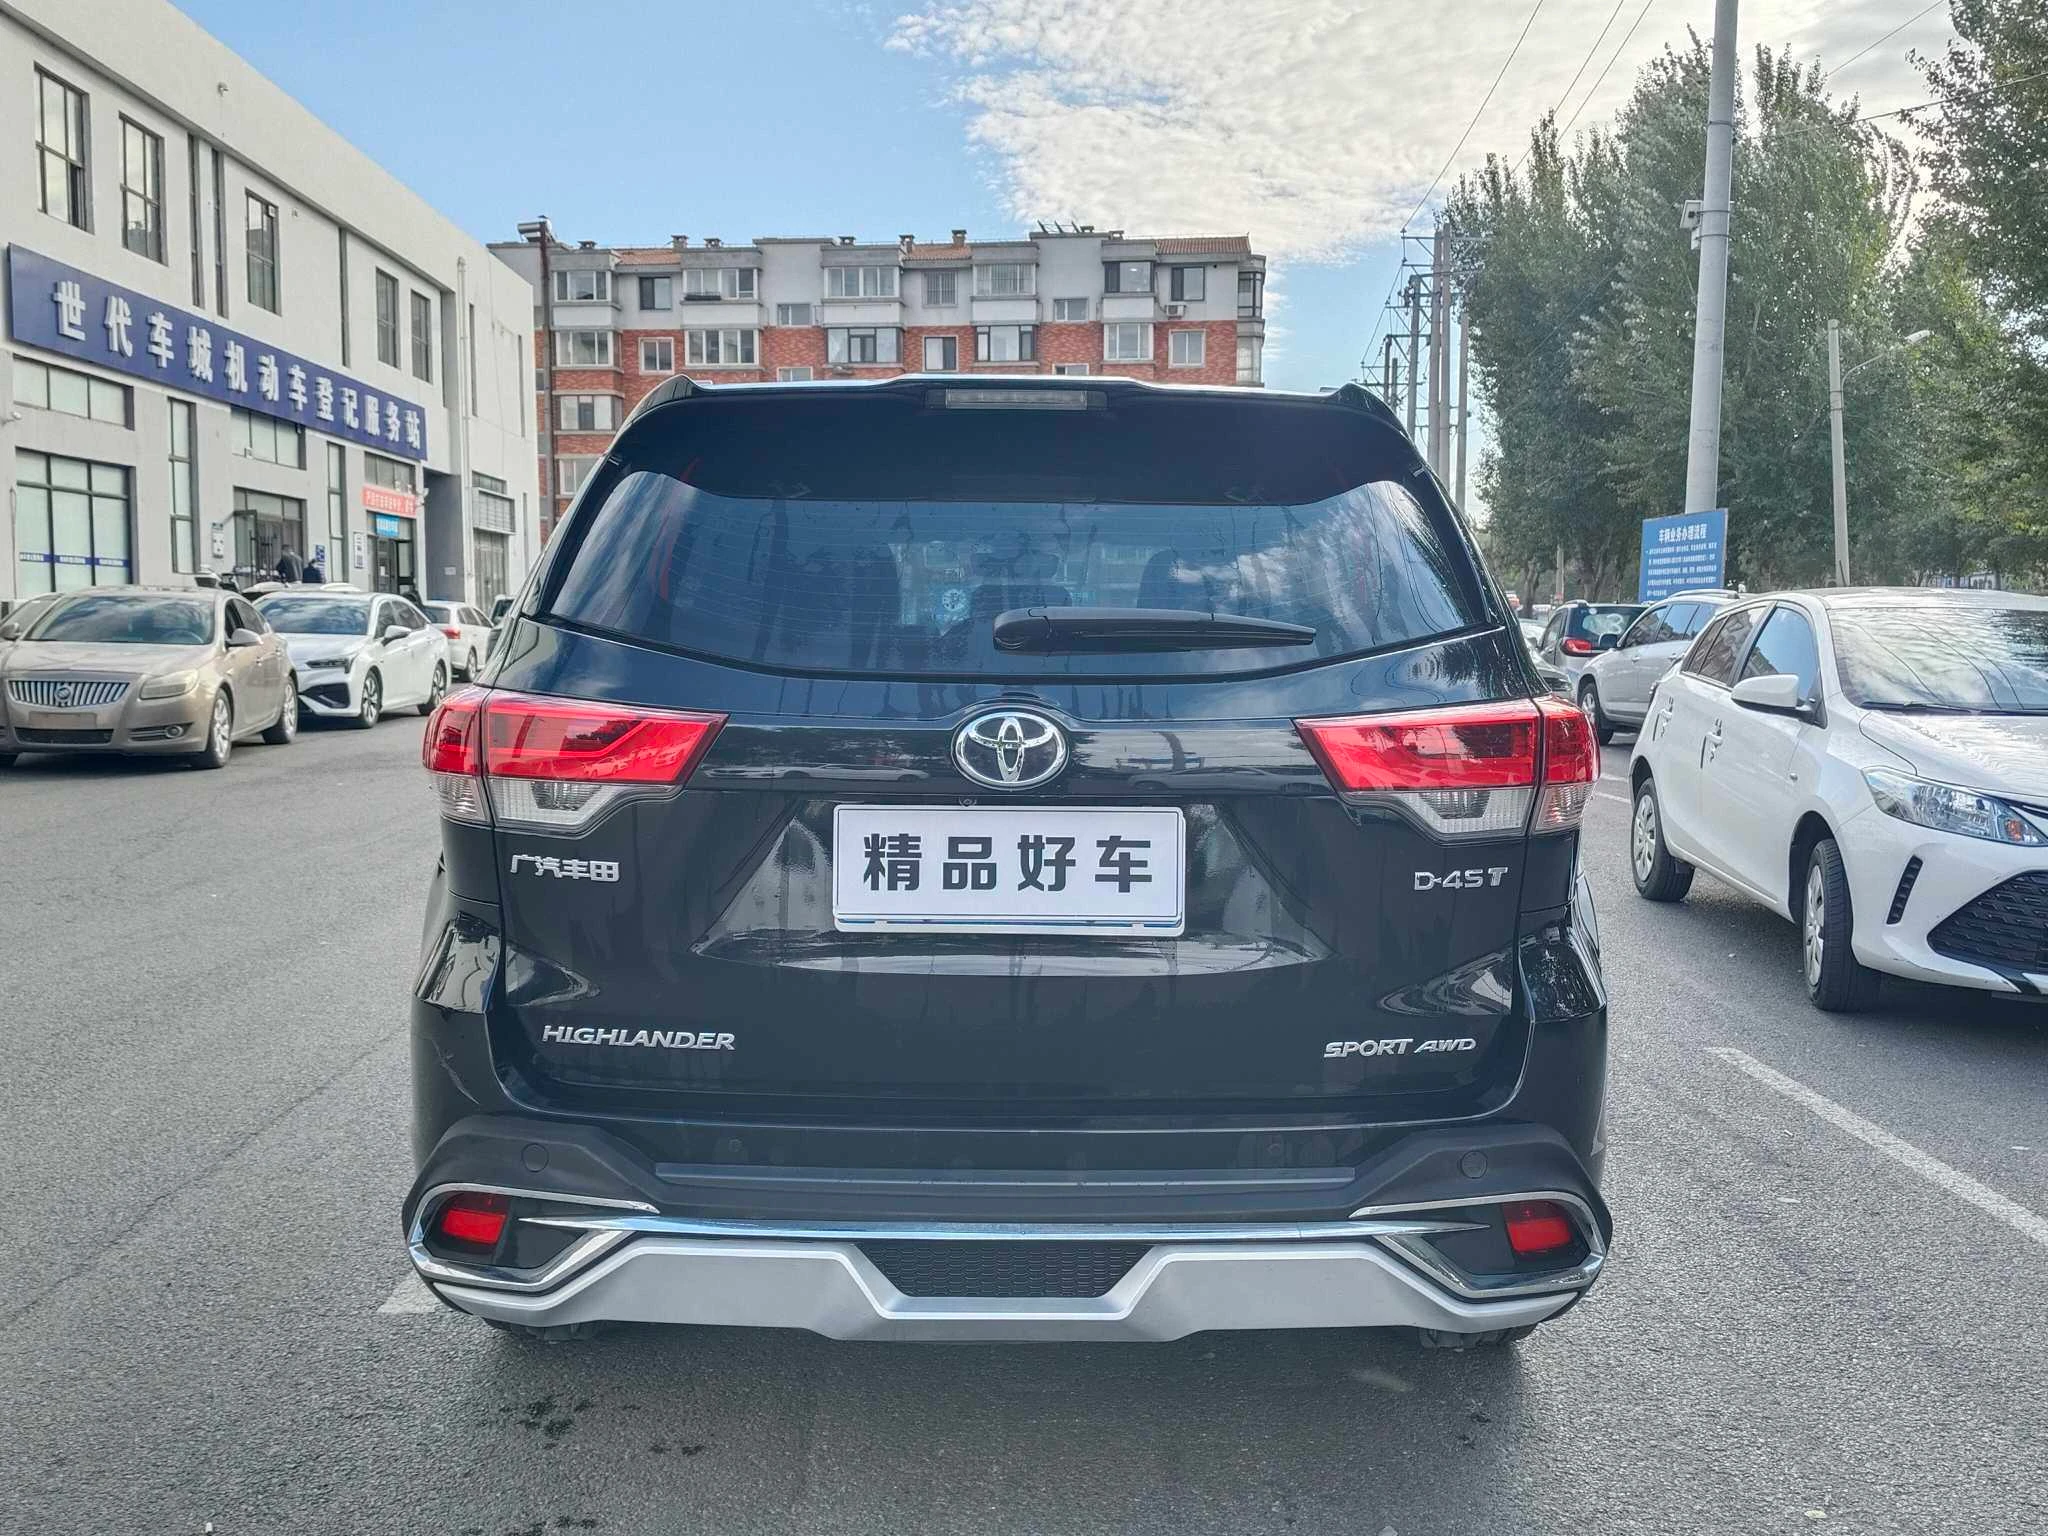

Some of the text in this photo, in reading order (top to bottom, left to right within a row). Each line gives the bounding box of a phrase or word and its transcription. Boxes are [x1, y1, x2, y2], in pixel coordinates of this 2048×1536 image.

[54, 280, 420, 450] 世代车城机动车登记服务站
[510, 854, 619, 882] 广汽丰田
[863, 832, 1153, 893] 精品好车
[541, 1024, 736, 1051] HIGHLANDER
[1323, 1037, 1477, 1059] SPORT AWD
